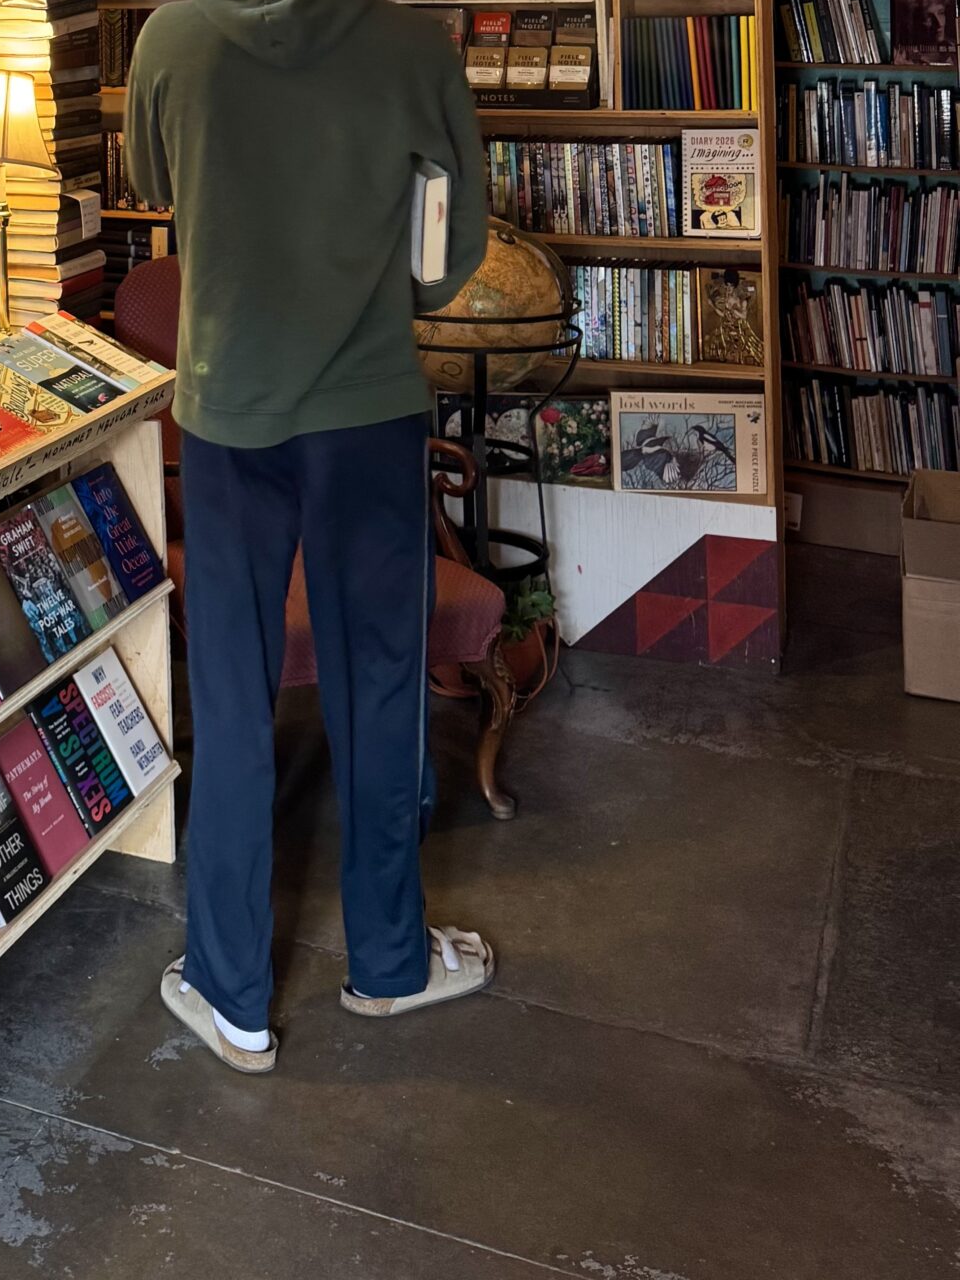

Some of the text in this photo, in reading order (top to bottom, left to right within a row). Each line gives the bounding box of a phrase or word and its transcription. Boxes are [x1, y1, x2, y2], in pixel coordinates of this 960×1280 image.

[483, 19, 503, 27] FIELD
[480, 94, 517, 103] NOTES
[690, 136, 735, 146] DIARY 2026
[619, 396, 696, 411] lost words
[43, 431, 92, 463] MOHAMED
[143, 388, 166, 410] SARR
[0, 519, 34, 546] GRAHAM
[12, 535, 35, 558] SWIFT
[59, 682, 130, 808] SPECTRUM
[3, 867, 45, 912] THINGS
